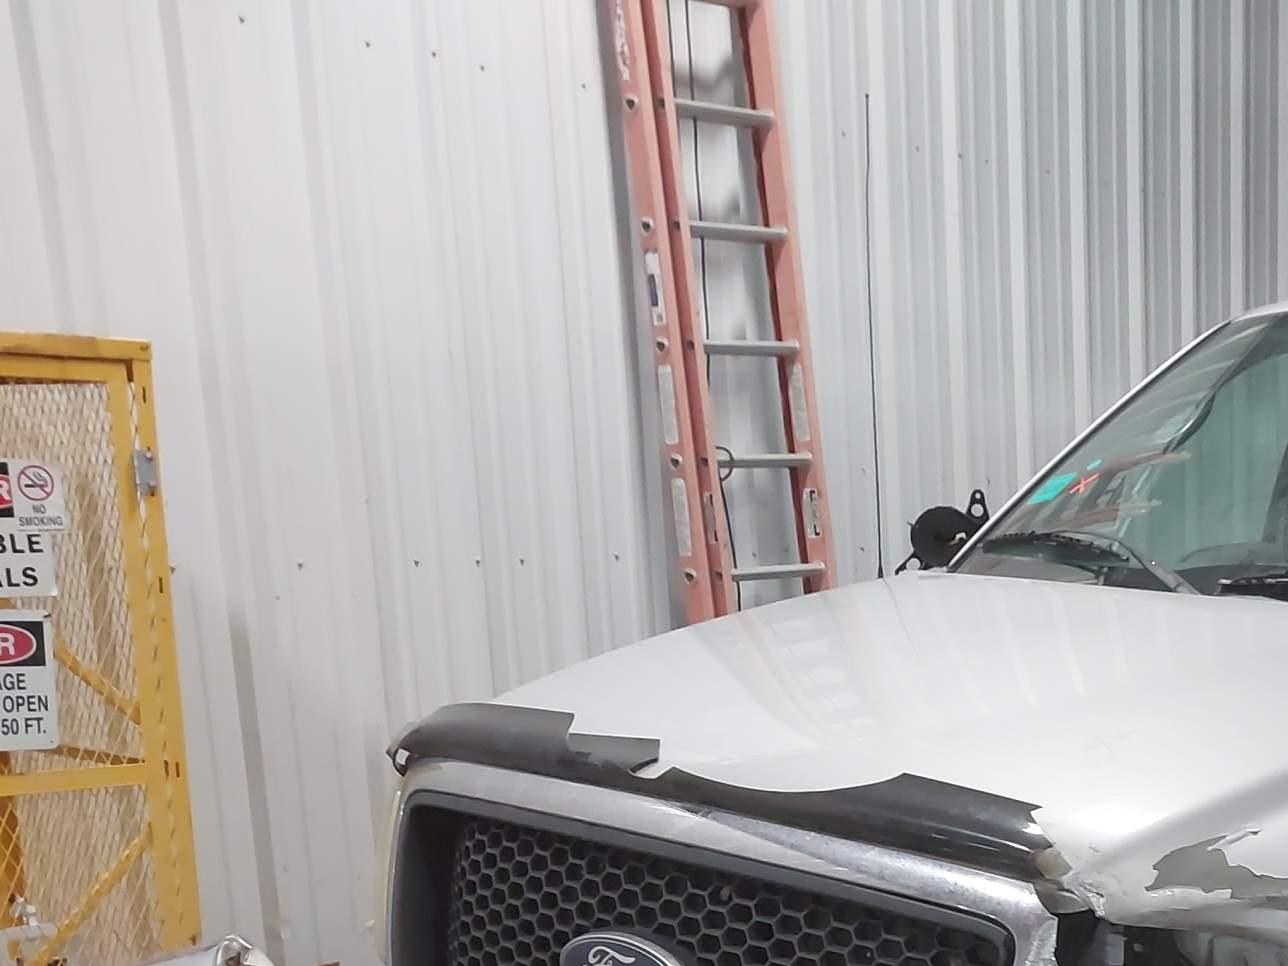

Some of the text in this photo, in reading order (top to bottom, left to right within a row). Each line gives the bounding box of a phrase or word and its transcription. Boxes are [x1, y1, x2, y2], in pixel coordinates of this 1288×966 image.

[32, 504, 47, 514] NO
[18, 516, 63, 527] SMOKING
[0, 566, 38, 588] LS
[0, 673, 26, 691] GE
[3, 695, 48, 713] OPEN
[1, 717, 47, 736] 50 FT.
